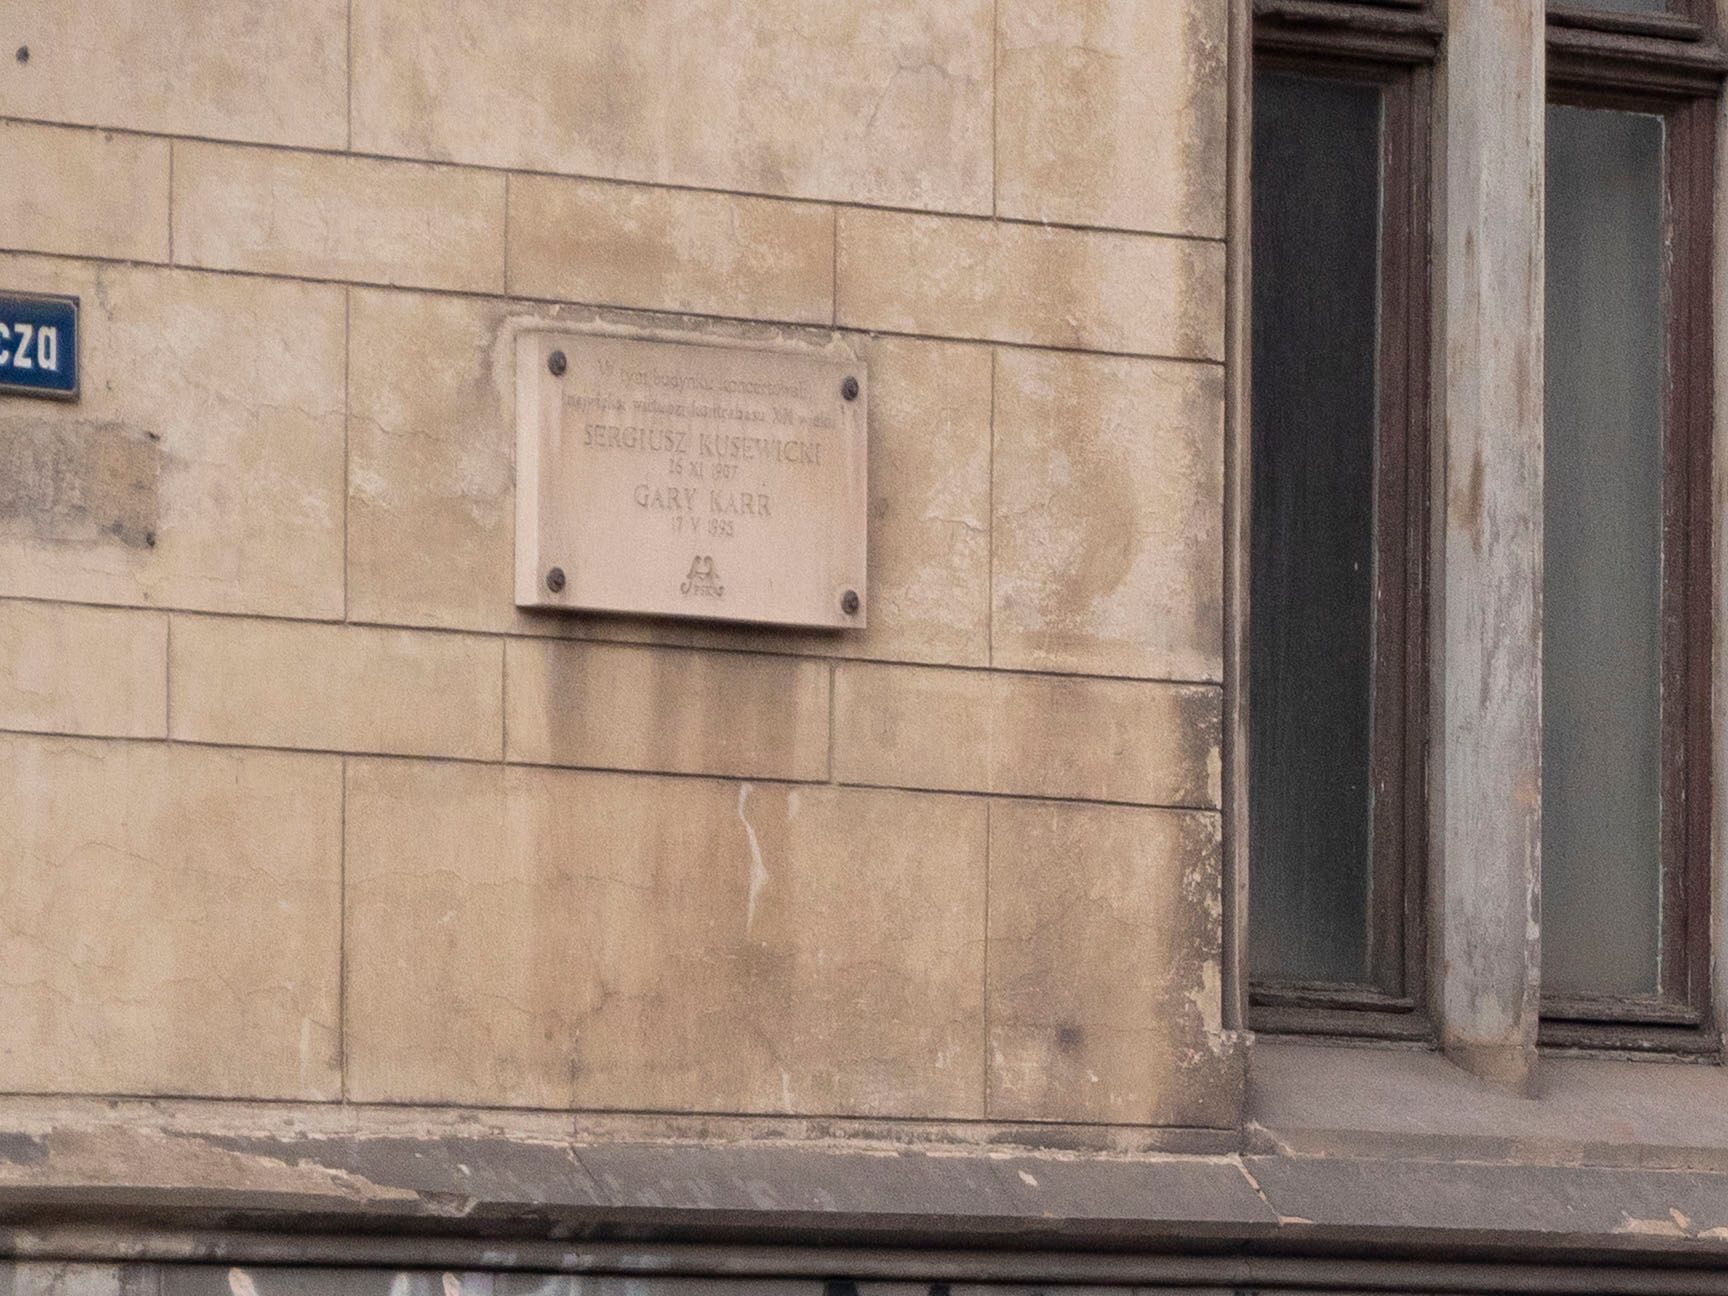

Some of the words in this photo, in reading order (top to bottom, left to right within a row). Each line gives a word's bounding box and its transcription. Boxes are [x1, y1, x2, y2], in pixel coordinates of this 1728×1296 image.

[583, 423, 689, 456] SERGIUSZ
[697, 432, 823, 467] KUSEWICKI
[688, 460, 704, 481] XI
[710, 462, 739, 483] 1907
[633, 483, 698, 512] GARY
[708, 488, 773, 518] KARR
[690, 516, 701, 535] V
[707, 517, 736, 540] 1995
